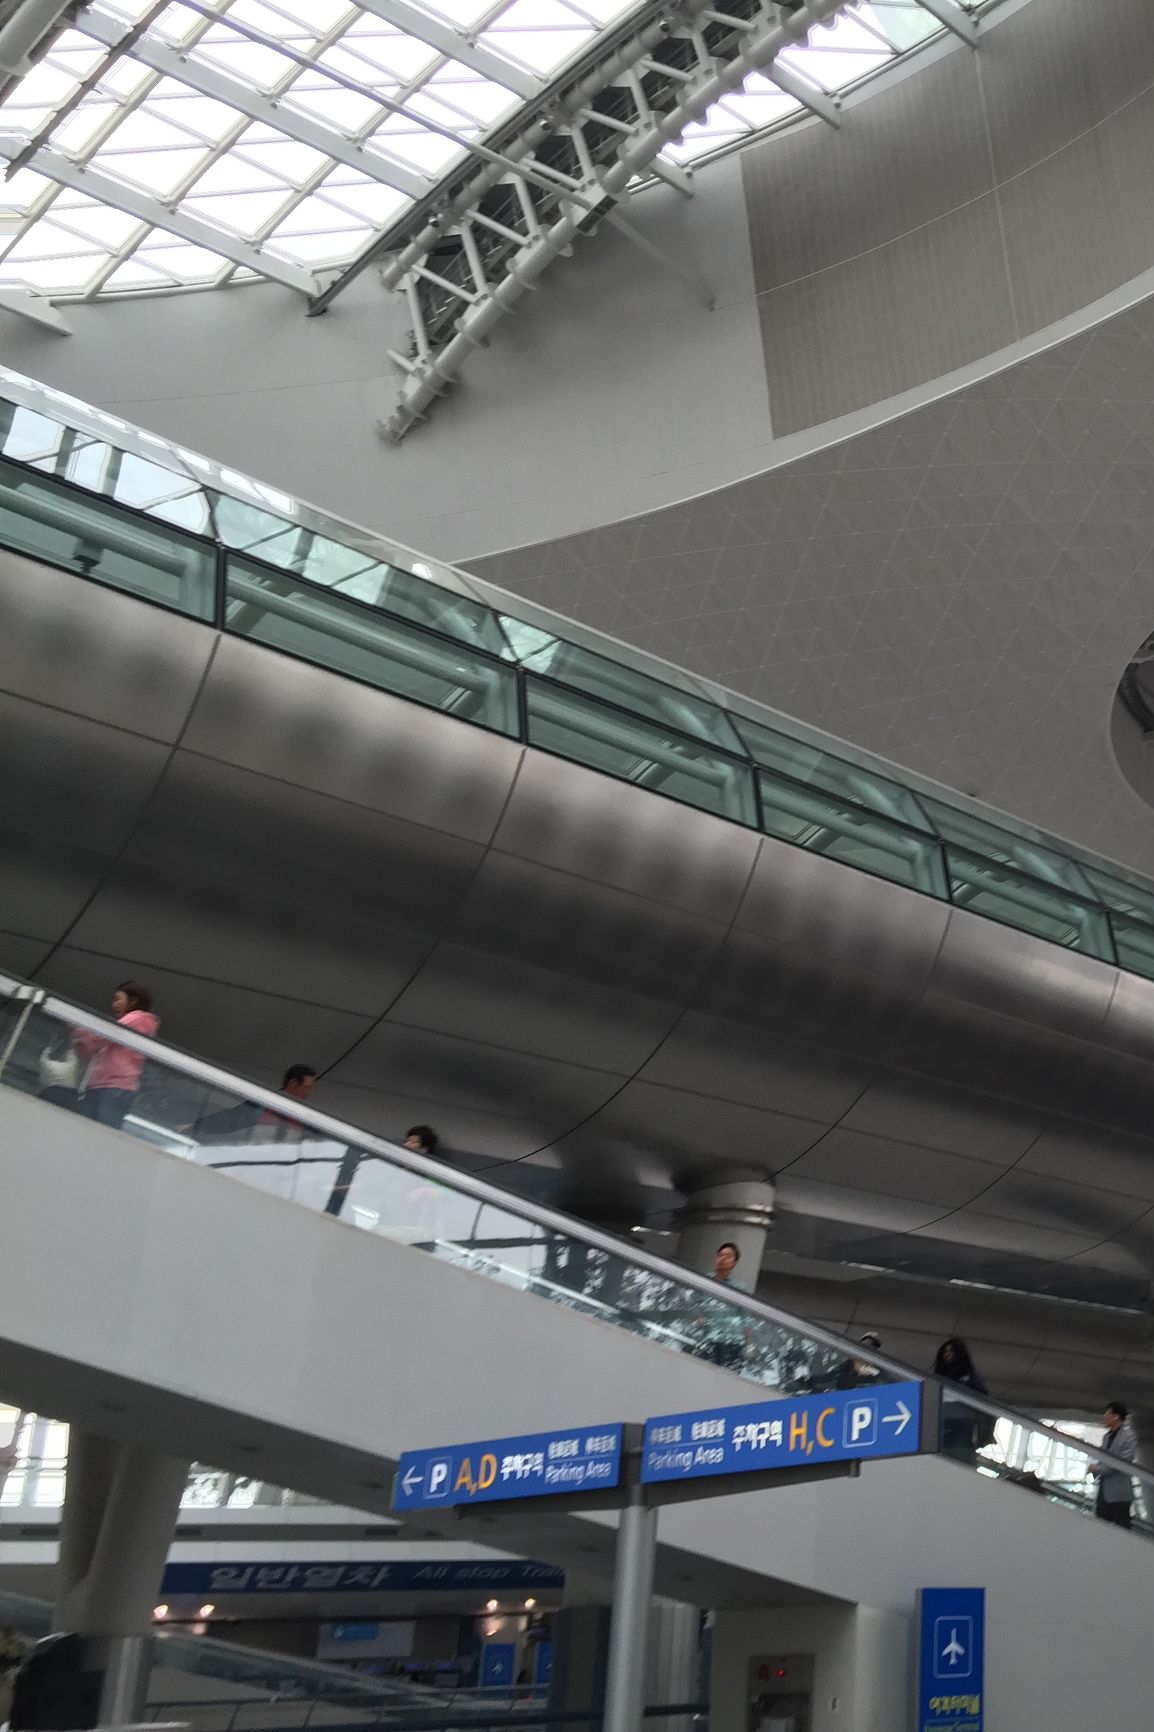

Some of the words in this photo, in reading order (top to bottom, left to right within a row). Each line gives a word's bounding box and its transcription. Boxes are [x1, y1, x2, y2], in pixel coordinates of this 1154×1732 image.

[732, 1420, 783, 1452] 주차구역
[789, 1407, 836, 1456] H,C
[851, 1406, 872, 1441] P
[545, 1463, 585, 1486] Parking
[585, 1460, 611, 1479] Area
[648, 1449, 693, 1472] Parking
[693, 1446, 724, 1465] Area
[430, 1463, 448, 1493] P
[209, 1565, 391, 1590] 일반열차
